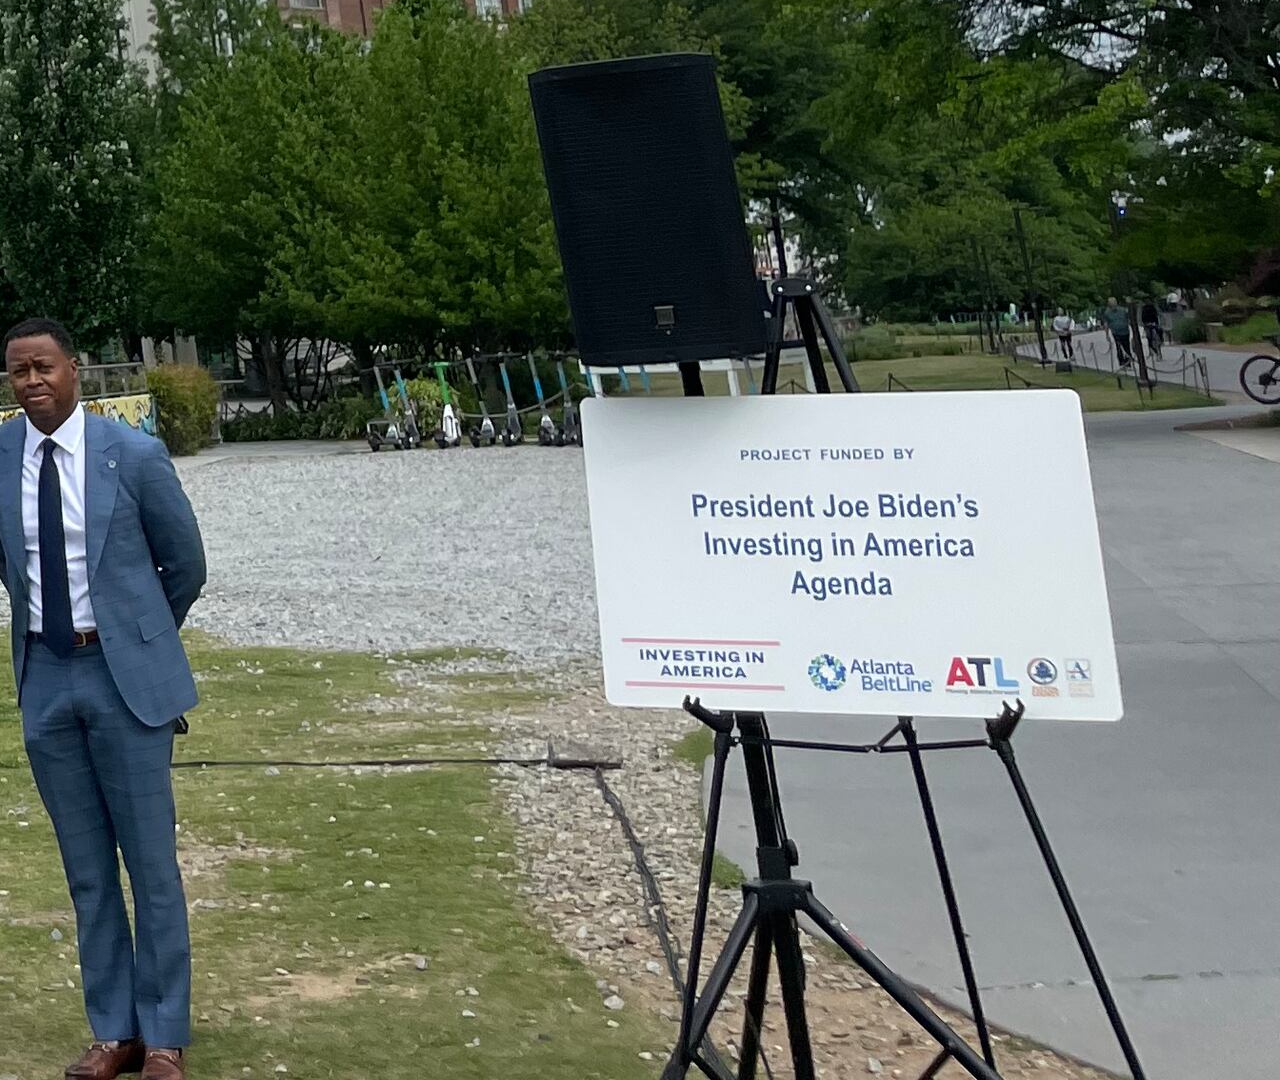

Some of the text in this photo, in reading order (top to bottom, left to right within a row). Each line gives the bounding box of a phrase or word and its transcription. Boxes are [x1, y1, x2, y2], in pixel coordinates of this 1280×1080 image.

[740, 448, 916, 461] PROJECT FUNDED BY
[691, 492, 979, 519] President Joe Biden's
[703, 531, 975, 562] Investing in America
[790, 570, 893, 601] Agenda
[639, 649, 765, 664] INVESTING IN
[660, 665, 747, 679] AMERICA
[850, 659, 915, 675] Atlanta
[946, 656, 1019, 688] ATL
[861, 675, 932, 693] BeltLine
